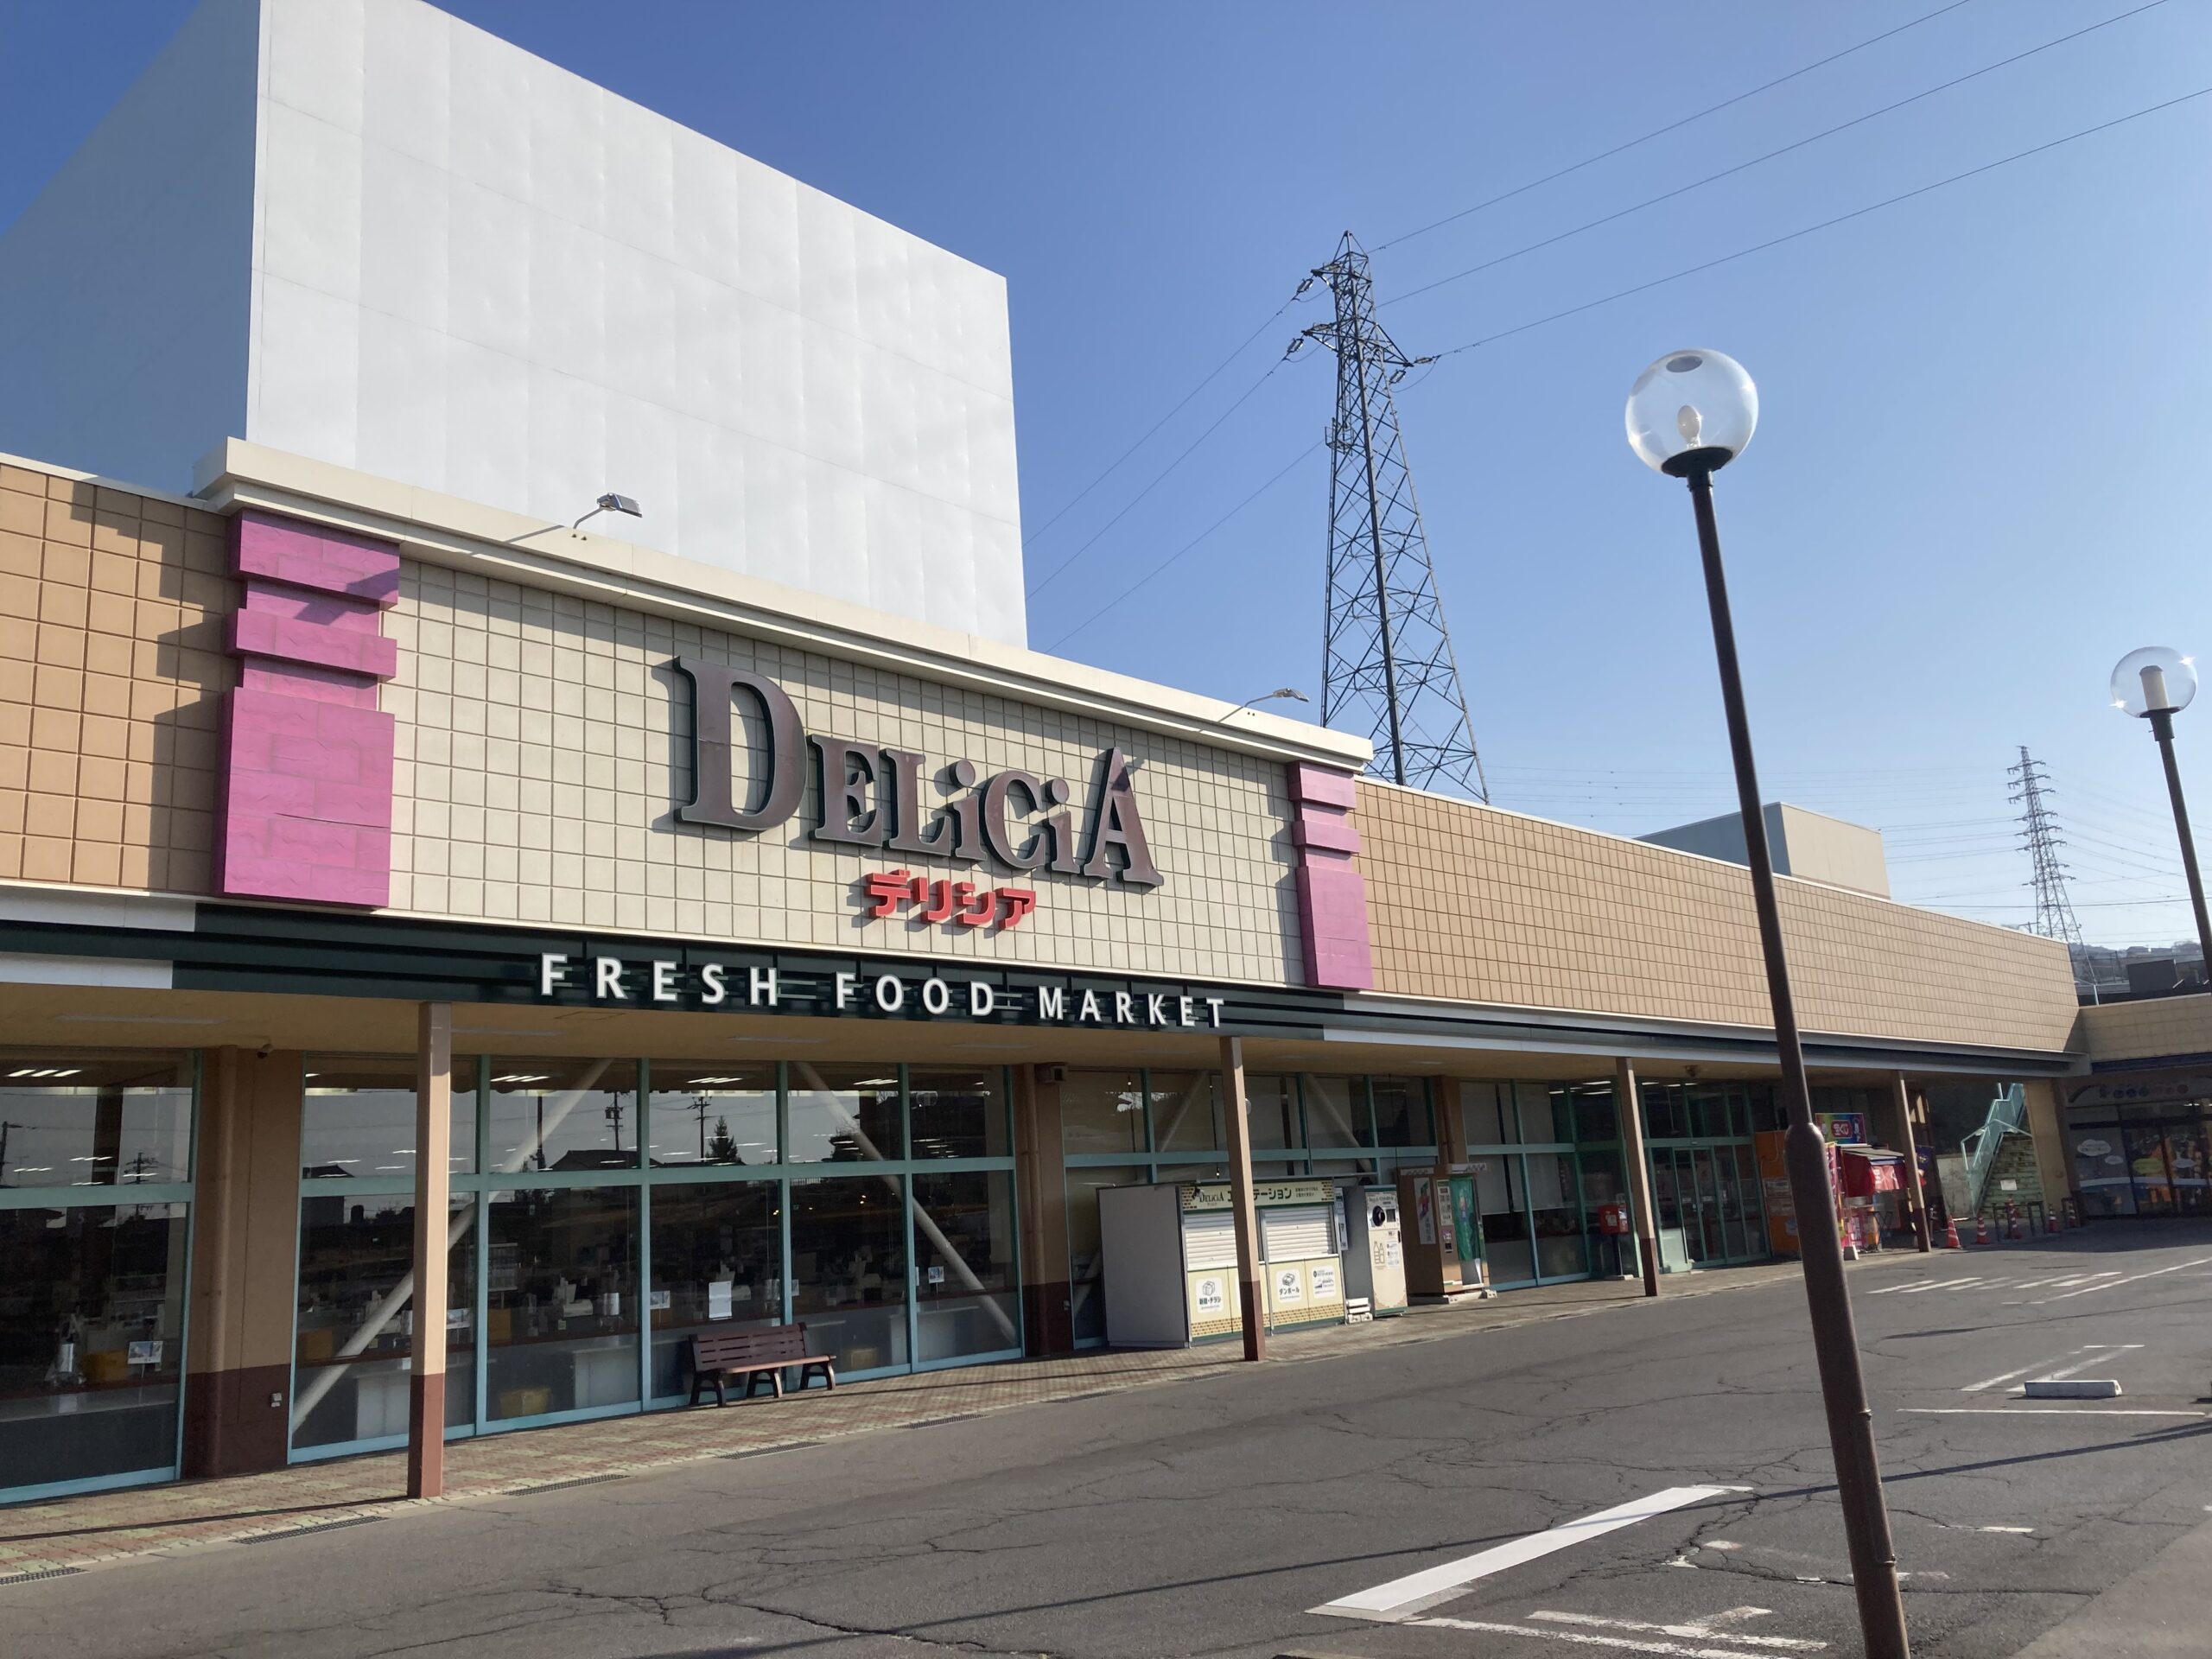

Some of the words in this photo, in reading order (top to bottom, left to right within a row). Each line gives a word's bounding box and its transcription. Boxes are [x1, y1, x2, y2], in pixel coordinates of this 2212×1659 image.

[865, 868, 1036, 930] デリシア
[540, 952, 779, 1007] FRESH
[834, 972, 995, 1017] FOOD
[1038, 986, 1225, 1028] MARKET
